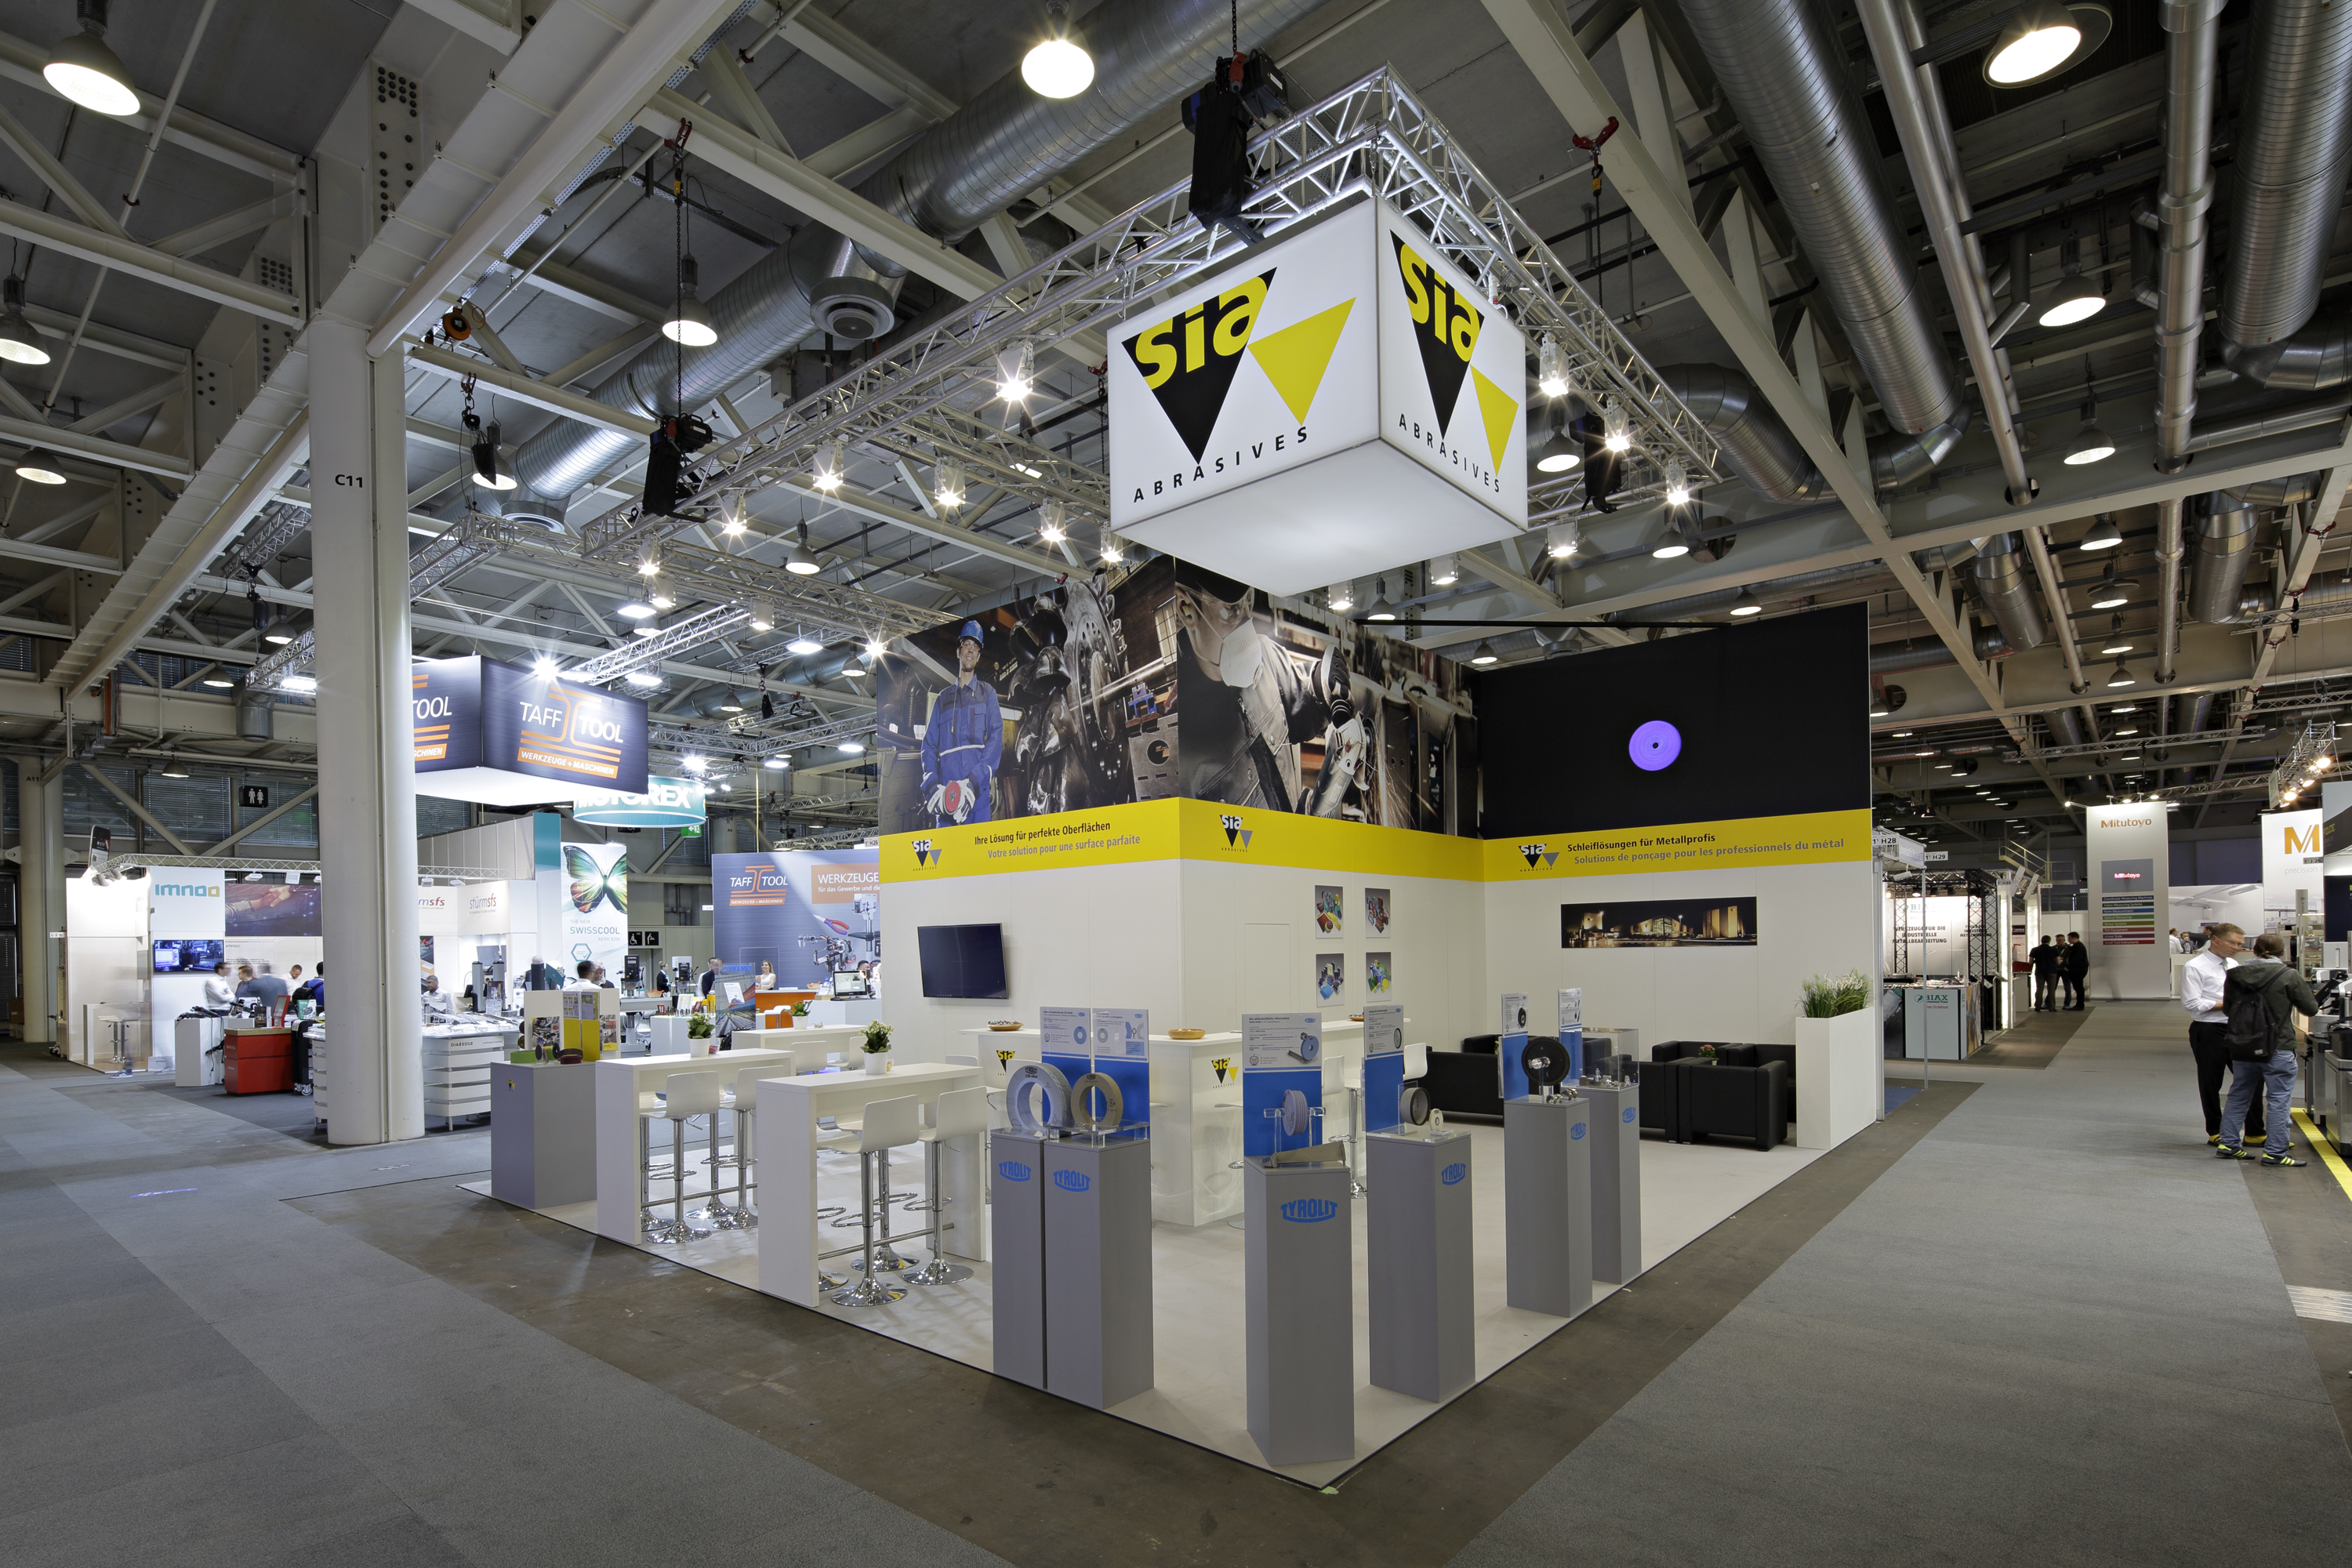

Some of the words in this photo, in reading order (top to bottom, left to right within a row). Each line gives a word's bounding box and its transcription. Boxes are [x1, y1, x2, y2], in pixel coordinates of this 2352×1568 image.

[1399, 243, 1483, 362] sia
[1134, 276, 1268, 390] sia
[1398, 413, 1501, 494] ABRASIVES
[1133, 426, 1308, 503] ABRASIVES
[335, 474, 363, 488] C11
[519, 701, 563, 728] TAFF
[579, 715, 624, 743] TOOL
[413, 747, 443, 757] SCHINEN
[521, 750, 568, 767] WERKZEUGE
[572, 761, 615, 775] MASCHINEN
[1221, 815, 1242, 830] sia
[2100, 818, 2152, 829] Mitutoyo
[975, 836, 988, 845] Ihre
[989, 833, 1014, 844] Lösung
[1016, 831, 1026, 840] für
[1028, 828, 1060, 841] perfekte
[1062, 821, 1111, 836] Oberflächen
[913, 839, 932, 853] sia
[988, 849, 1007, 858] Votre
[1008, 845, 1038, 856] solution
[1040, 844, 1057, 855] pour
[1059, 842, 1073, 851] une
[1075, 838, 1104, 851] surface
[1106, 834, 1141, 849] parfaite
[1520, 843, 1546, 855] sia
[1567, 839, 1637, 852] Schleiflösungen
[1639, 838, 1653, 847] für
[1656, 833, 1715, 846] Metallprofis
[1574, 853, 1615, 864] Solutions
[1617, 852, 1628, 861] de
[1632, 851, 1671, 862] ponçage
[1674, 850, 1697, 859] pour
[1699, 848, 1713, 856] les
[1715, 842, 1792, 857] professionnels
[1795, 840, 1809, 850] du
[1812, 838, 1844, 849] métal
[818, 872, 880, 885] WERKZEUGE
[2285, 866, 2318, 875] precision
[730, 877, 753, 887] TAFF
[762, 876, 789, 887] TOOL
[469, 892, 496, 909] stürmsfs
[997, 1051, 1014, 1060] sia
[1213, 1058, 1230, 1070] sia
[1622, 1106, 1636, 1123] TYROLIT
[1570, 1122, 1586, 1140] TYROLIT
[998, 1161, 1032, 1182] TYROLIT
[1442, 1163, 1466, 1185] TYROLIT
[1053, 1170, 1091, 1192] TYROLIT
[1280, 1198, 1338, 1223] TYROLIT
